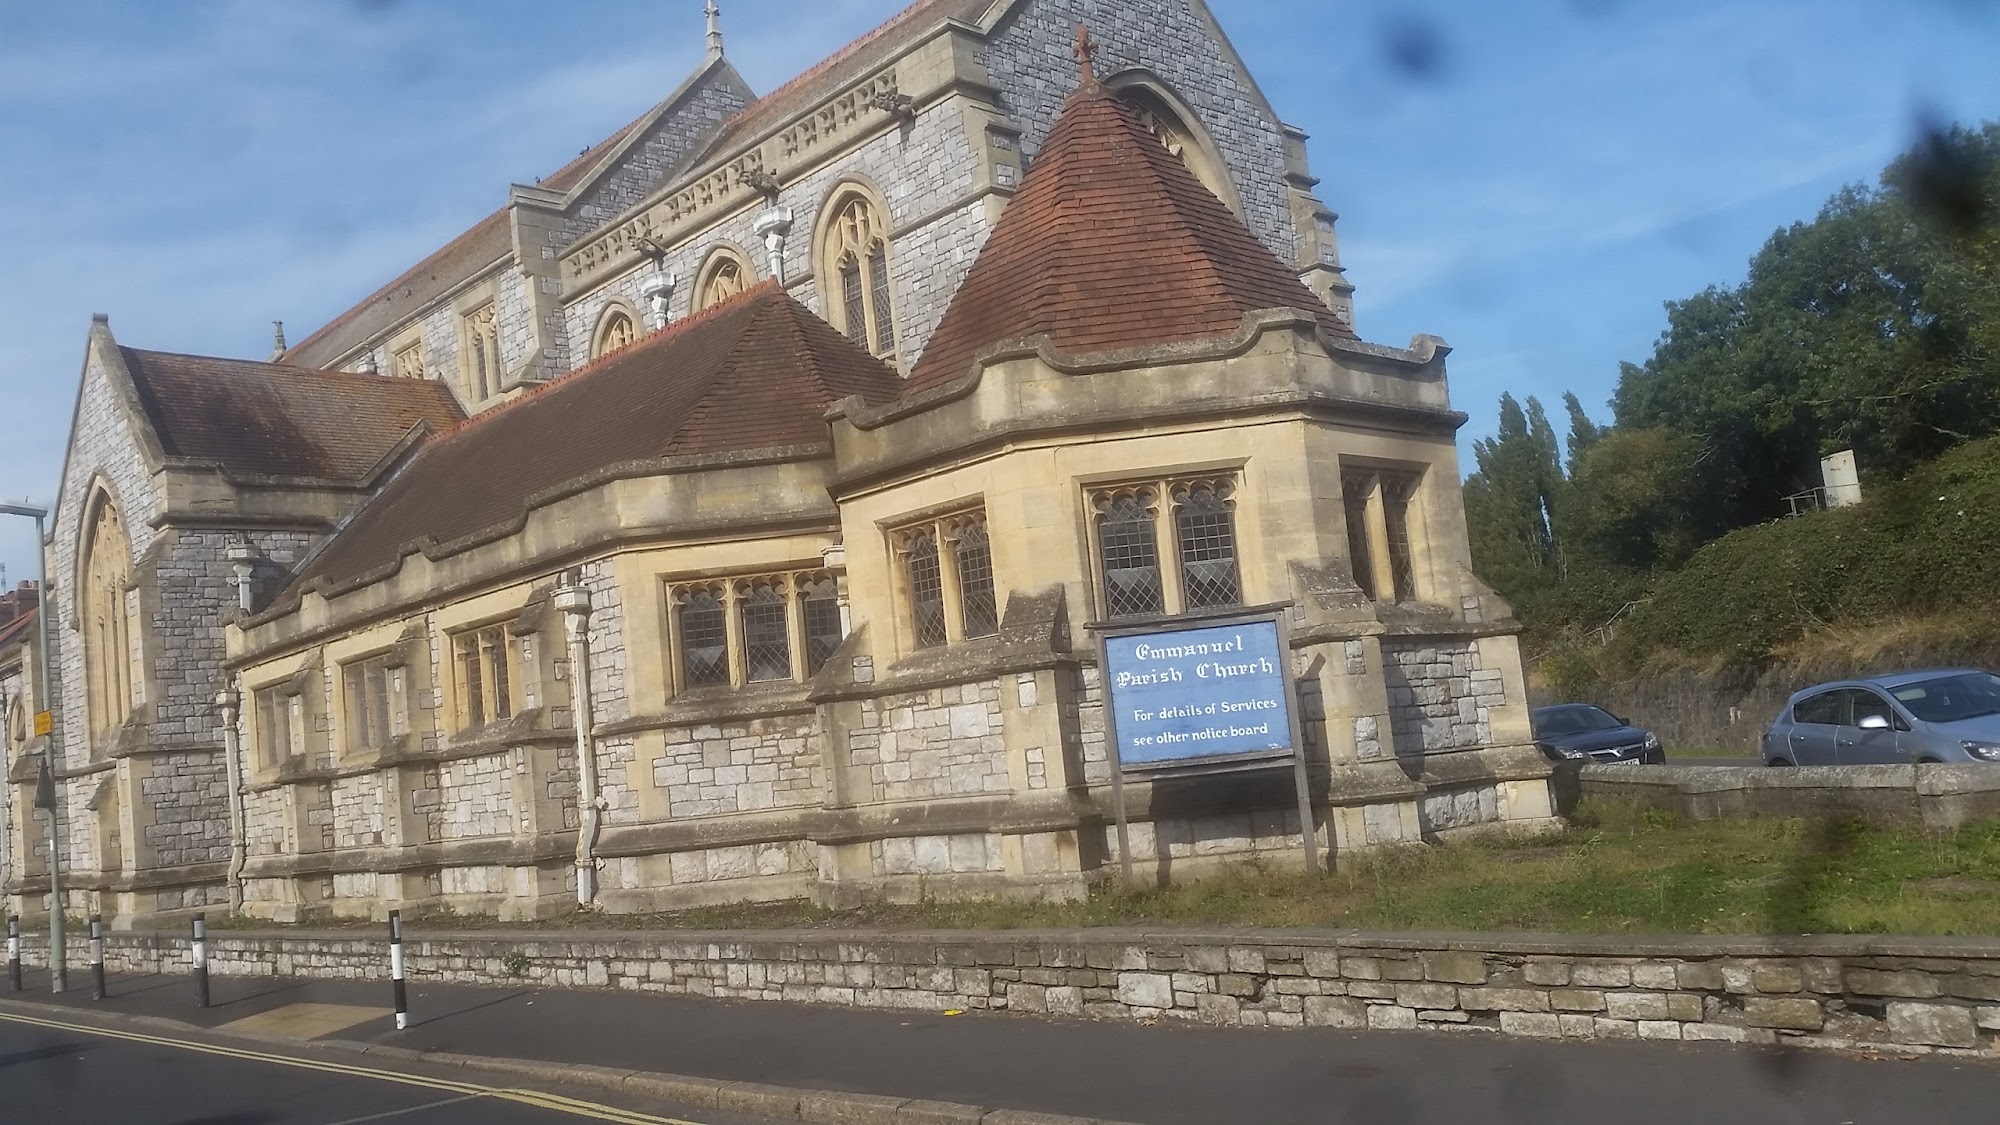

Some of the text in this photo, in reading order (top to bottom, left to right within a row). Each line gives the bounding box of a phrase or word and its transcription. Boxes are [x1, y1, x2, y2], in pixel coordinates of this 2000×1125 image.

[1135, 634, 1244, 661] Emmanuel
[1116, 656, 1273, 688] Parish Church
[1134, 699, 1277, 722] For details of Services
[1133, 722, 1268, 746] see other notice board
